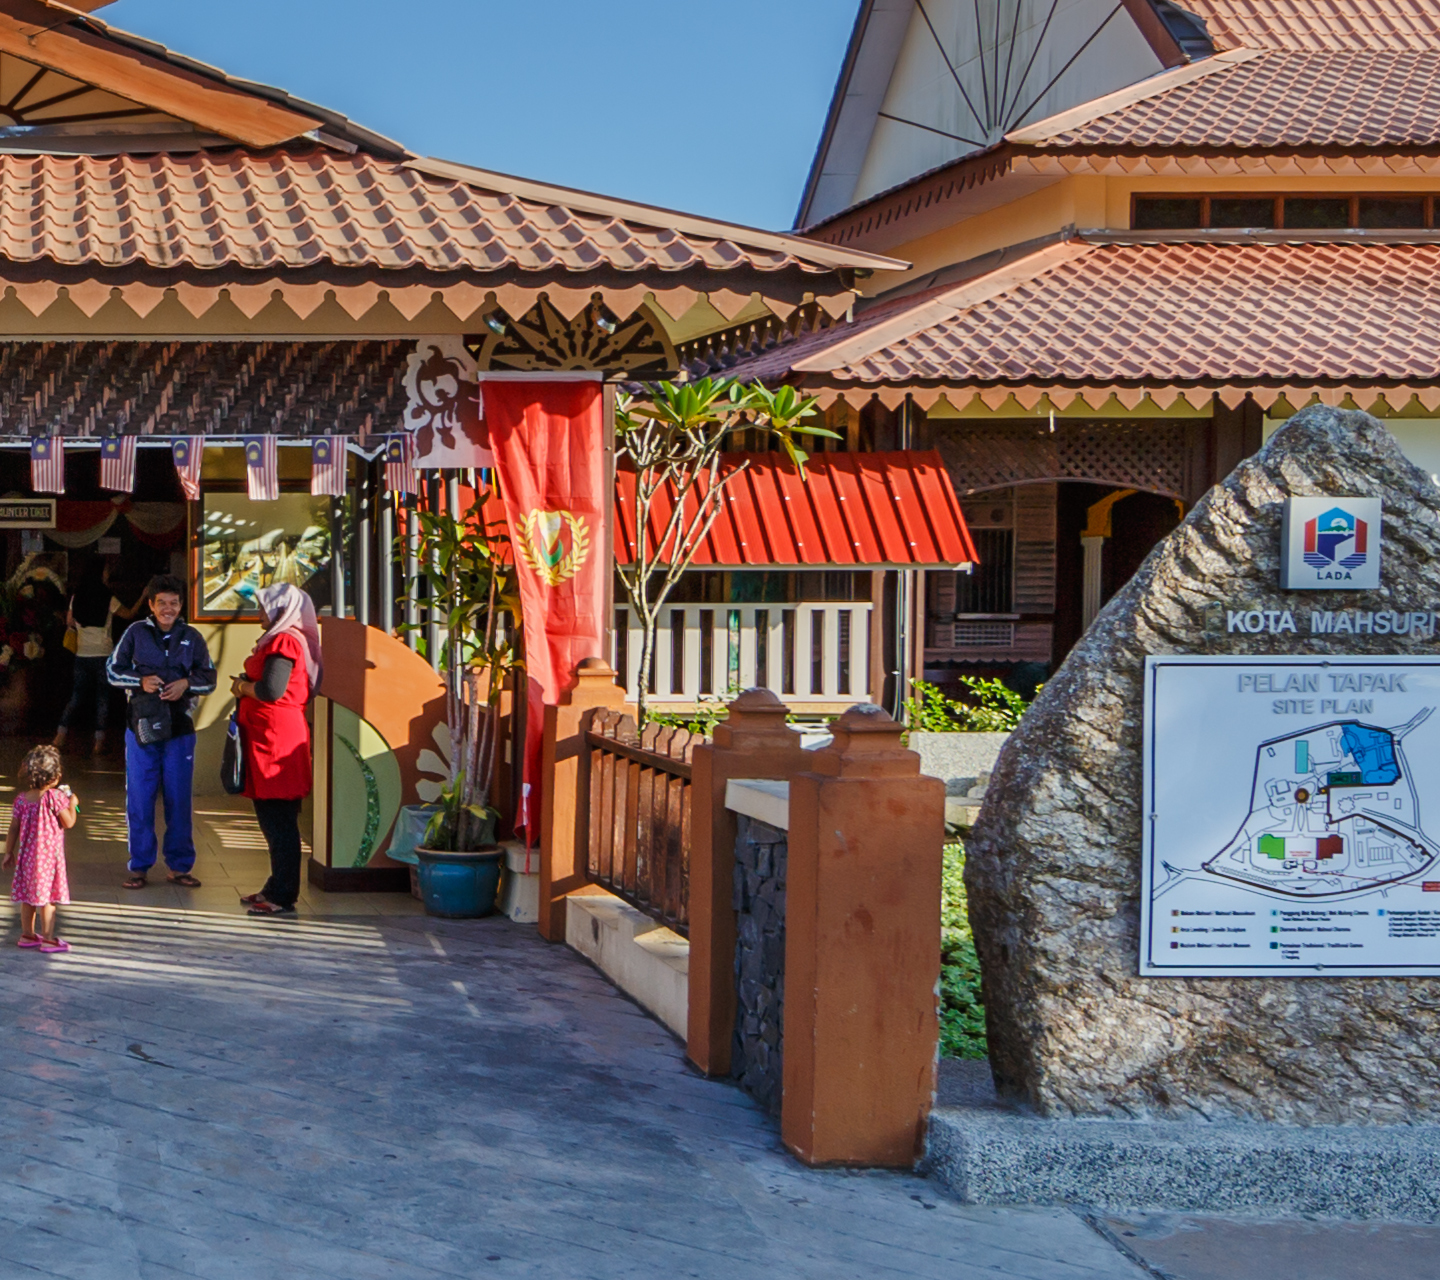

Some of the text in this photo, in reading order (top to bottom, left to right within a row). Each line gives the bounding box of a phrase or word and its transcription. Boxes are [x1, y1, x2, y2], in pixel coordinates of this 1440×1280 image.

[1317, 571, 1353, 580] LADA
[1227, 610, 1437, 635] KOTA MAHSURI
[1238, 673, 1408, 693] PELAN TAPAK
[1272, 699, 1374, 714] SITE PLAN
